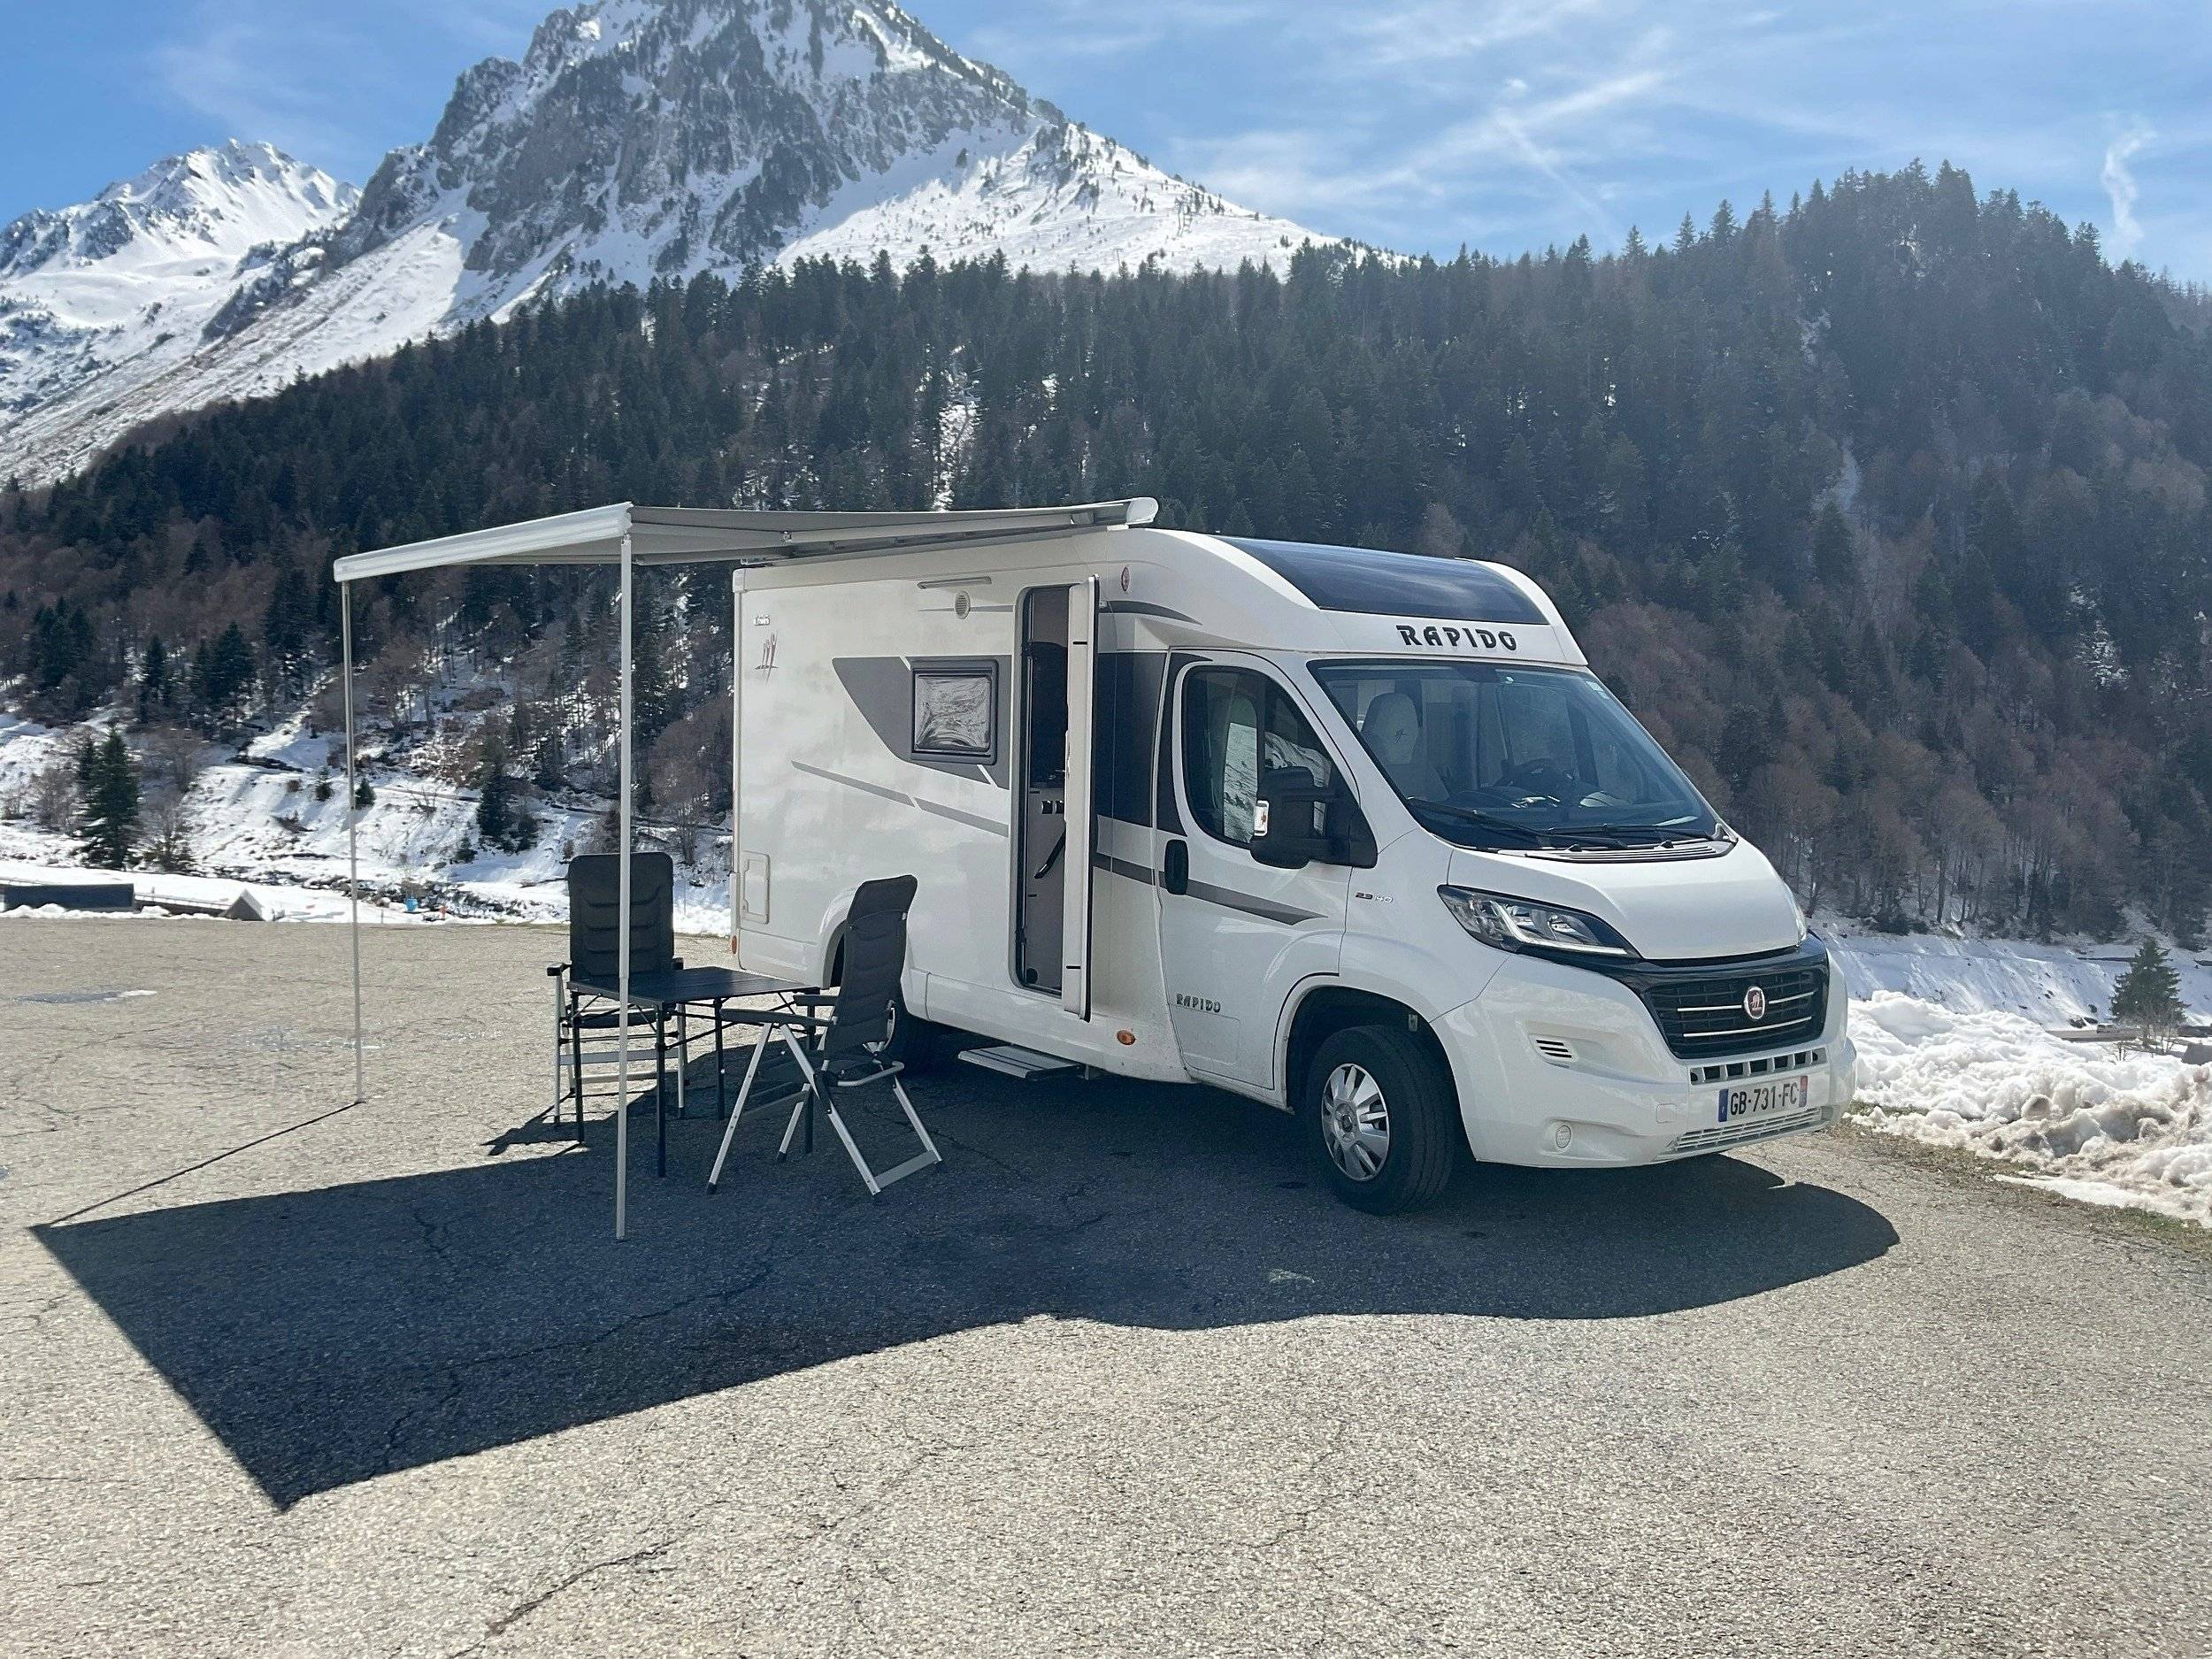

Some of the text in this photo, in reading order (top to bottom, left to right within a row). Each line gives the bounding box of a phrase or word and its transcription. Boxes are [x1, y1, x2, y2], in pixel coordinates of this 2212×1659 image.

[1395, 625, 1517, 651] RAPIDO
[1176, 993, 1221, 1013] RAPIDO
[1730, 1081, 1799, 1116] GB-731-FC
